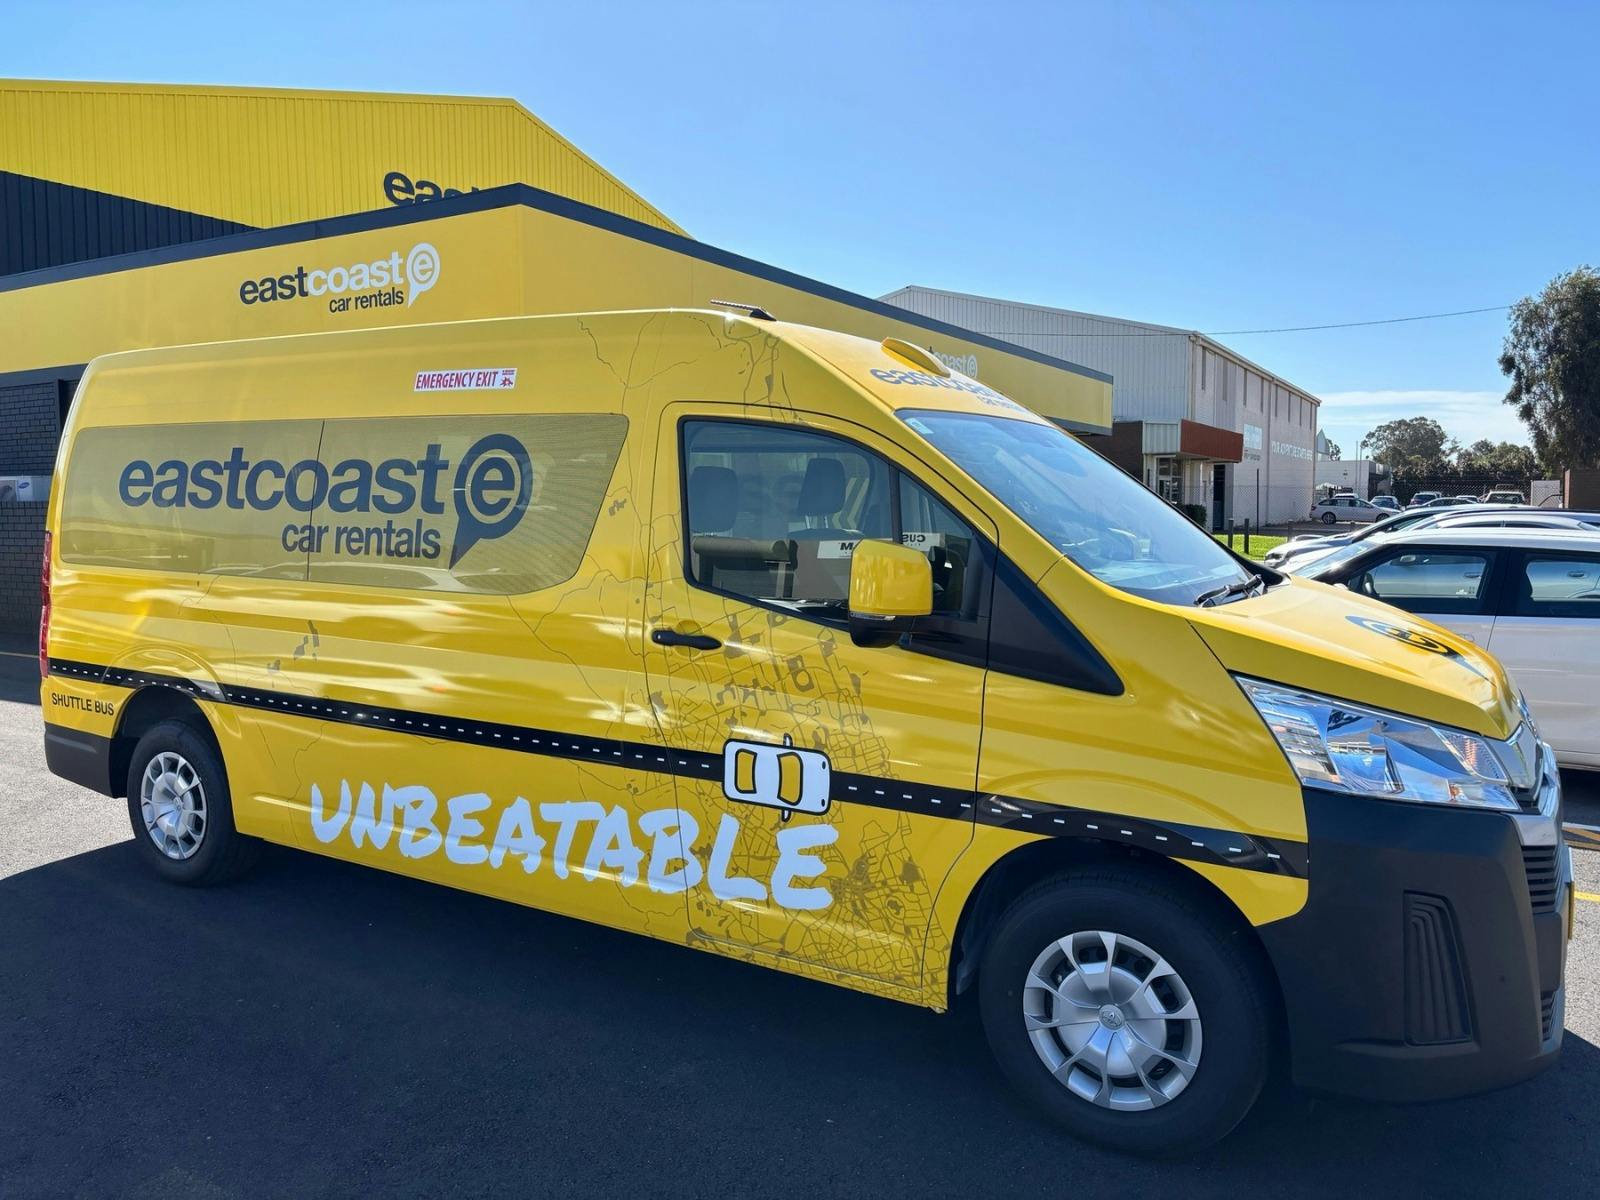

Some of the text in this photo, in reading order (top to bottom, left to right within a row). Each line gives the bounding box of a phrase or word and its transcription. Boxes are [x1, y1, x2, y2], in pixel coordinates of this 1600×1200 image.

[239, 251, 404, 305] eastcoast
[329, 287, 404, 313] car rentals
[416, 372, 476, 389] EMERGENCY
[475, 371, 498, 387] EXIT
[118, 443, 449, 515] eastcoast
[281, 518, 441, 559] car rentals
[51, 692, 115, 716] SHUTTLE BUS
[311, 778, 839, 911] UNBEATABLE
